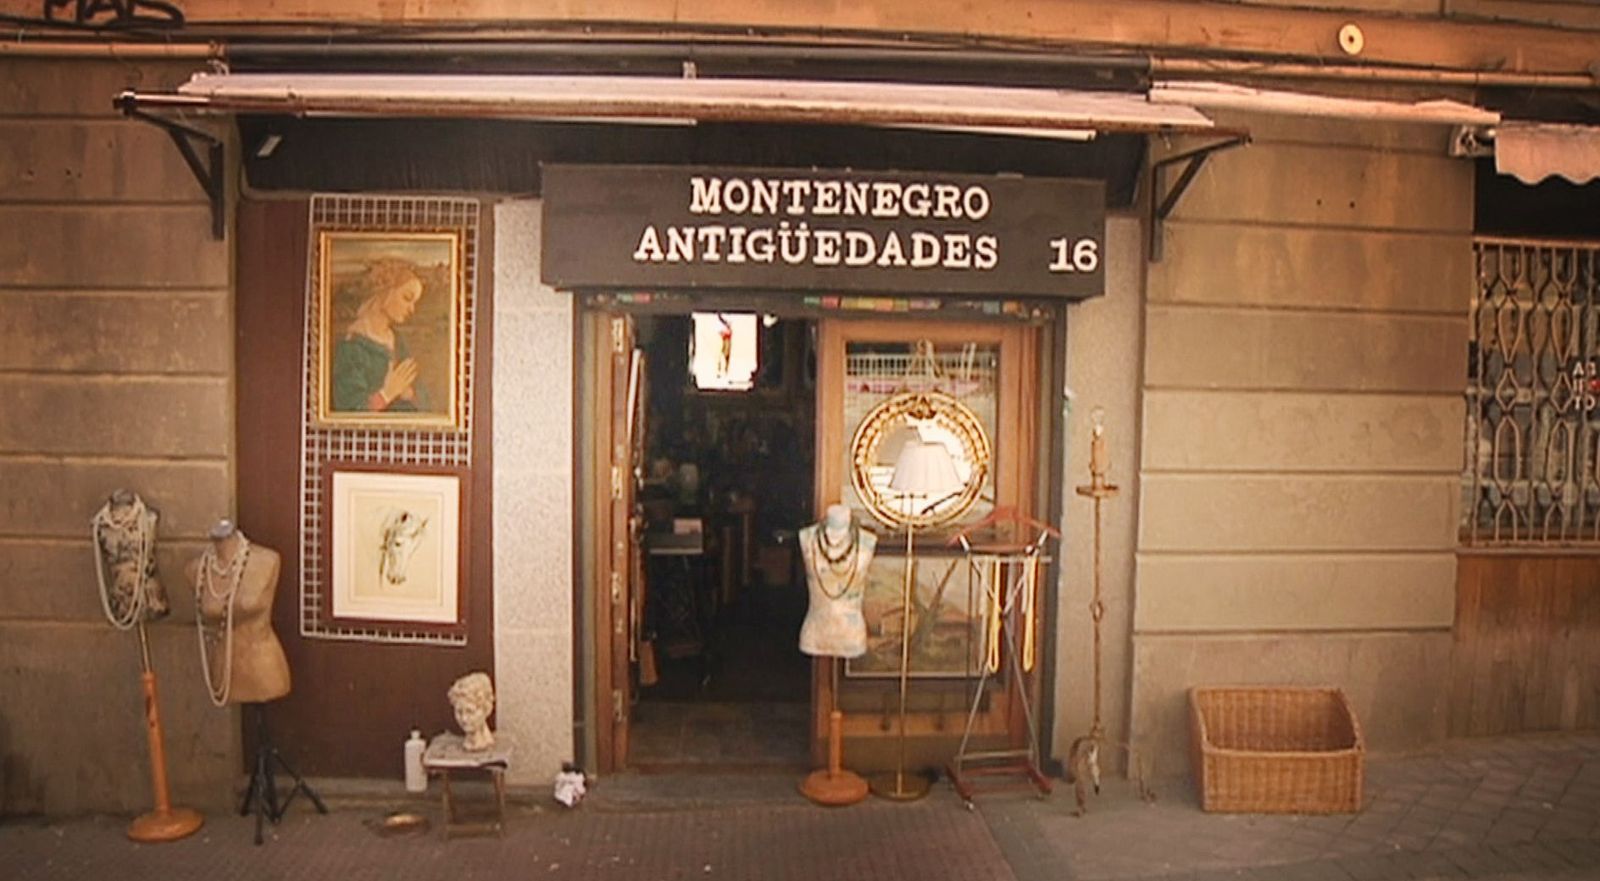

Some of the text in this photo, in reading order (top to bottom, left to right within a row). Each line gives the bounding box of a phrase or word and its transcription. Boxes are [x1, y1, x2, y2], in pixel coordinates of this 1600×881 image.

[689, 177, 991, 220] MONTENEGRO
[633, 221, 998, 268] ANTIGÜEDADES
[1049, 238, 1099, 272] 16
